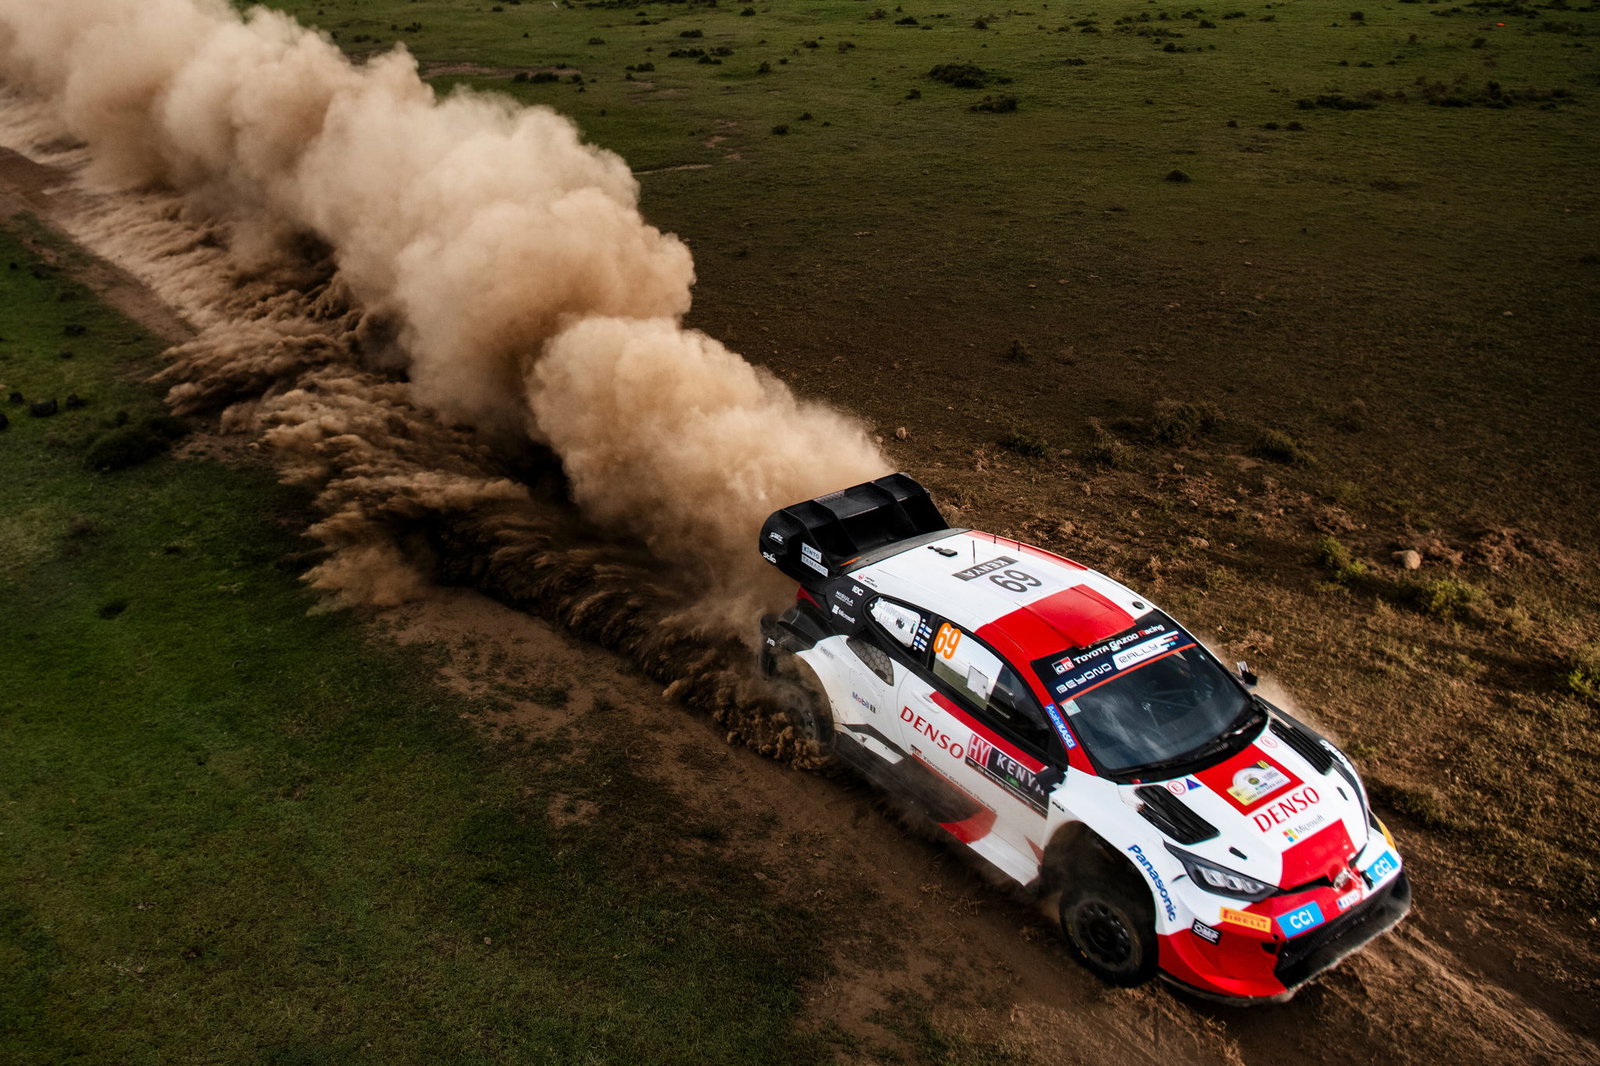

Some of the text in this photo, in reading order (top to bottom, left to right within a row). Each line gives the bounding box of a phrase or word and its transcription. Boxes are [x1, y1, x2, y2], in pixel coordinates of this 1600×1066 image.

[961, 559, 1009, 577] KENYA
[989, 570, 1042, 592] 69
[933, 622, 962, 660] 69
[1053, 624, 1166, 675] GR TOYOTA GAZOO Racing
[1056, 644, 1158, 694] BEYOND RALLY
[852, 691, 870, 709] Mobil
[900, 705, 964, 759] DENSO
[968, 735, 992, 767] HY
[1253, 787, 1320, 833] DENSO
[1294, 814, 1327, 835] Microsoft
[1374, 857, 1393, 877] CCI
[1127, 844, 1177, 922] Panasonic
[1222, 909, 1268, 930] PIRELLI
[1289, 908, 1315, 929] CCI
[1193, 922, 1220, 942] OMP
